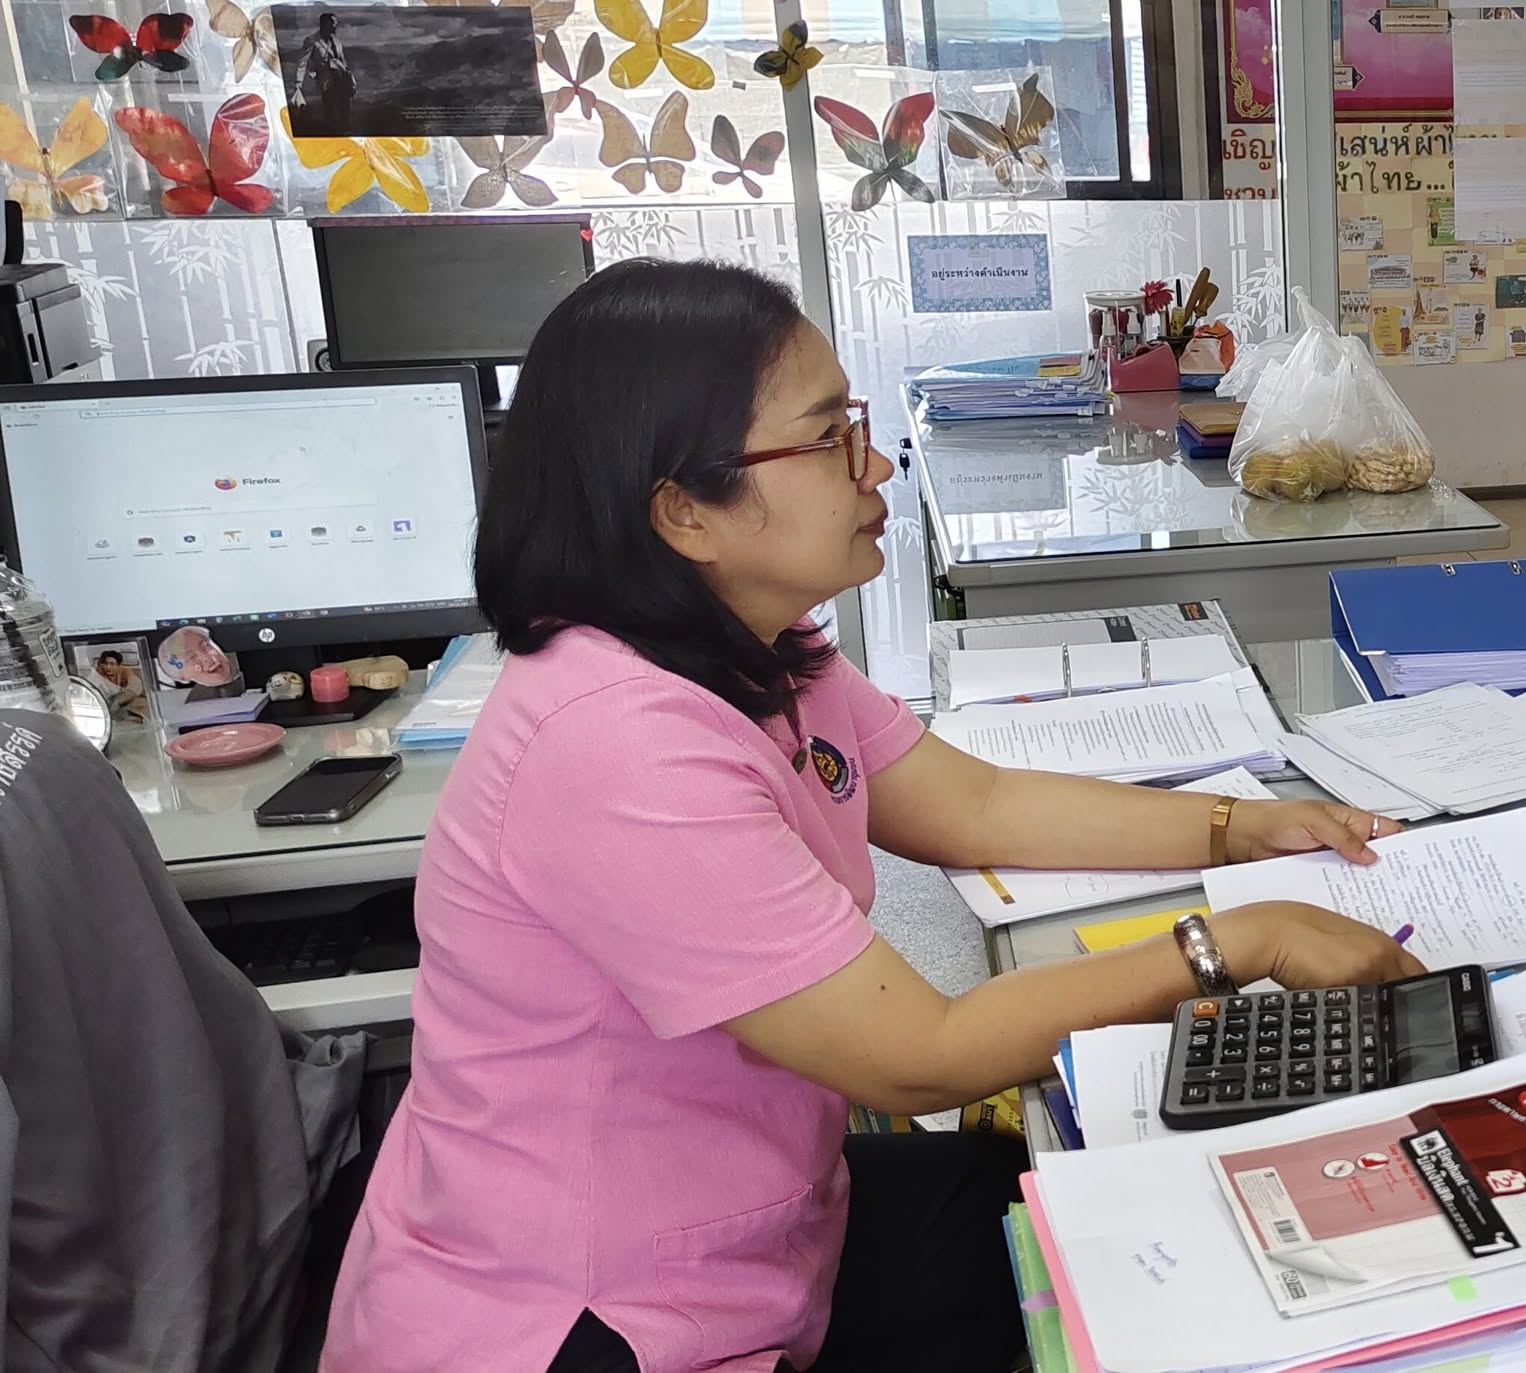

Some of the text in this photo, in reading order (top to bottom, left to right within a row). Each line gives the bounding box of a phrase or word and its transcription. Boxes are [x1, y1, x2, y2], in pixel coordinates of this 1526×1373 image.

[931, 266, 1028, 281] อยู่ระหว่างดำเนินงาน
[242, 475, 281, 487] Firefox
[1461, 972, 1471, 992] CASIO
[1198, 1001, 1213, 1010] C
[1228, 1017, 1246, 1025] 1
[1262, 1014, 1279, 1023] 4
[1294, 1012, 1312, 1021] 7
[1195, 1020, 1212, 1028] 0
[1226, 1032, 1244, 1041] 2
[1260, 1029, 1278, 1039] 5
[1293, 1027, 1311, 1036] 8
[1193, 1034, 1209, 1046] 00
[1259, 1045, 1276, 1055] 6
[1293, 1042, 1310, 1052] 9
[1224, 1048, 1242, 1057] 3
[1436, 1147, 1466, 1187] Elephant
[1416, 1154, 1455, 1207] บิลเงินสด
[1492, 1173, 1513, 1189] 2
